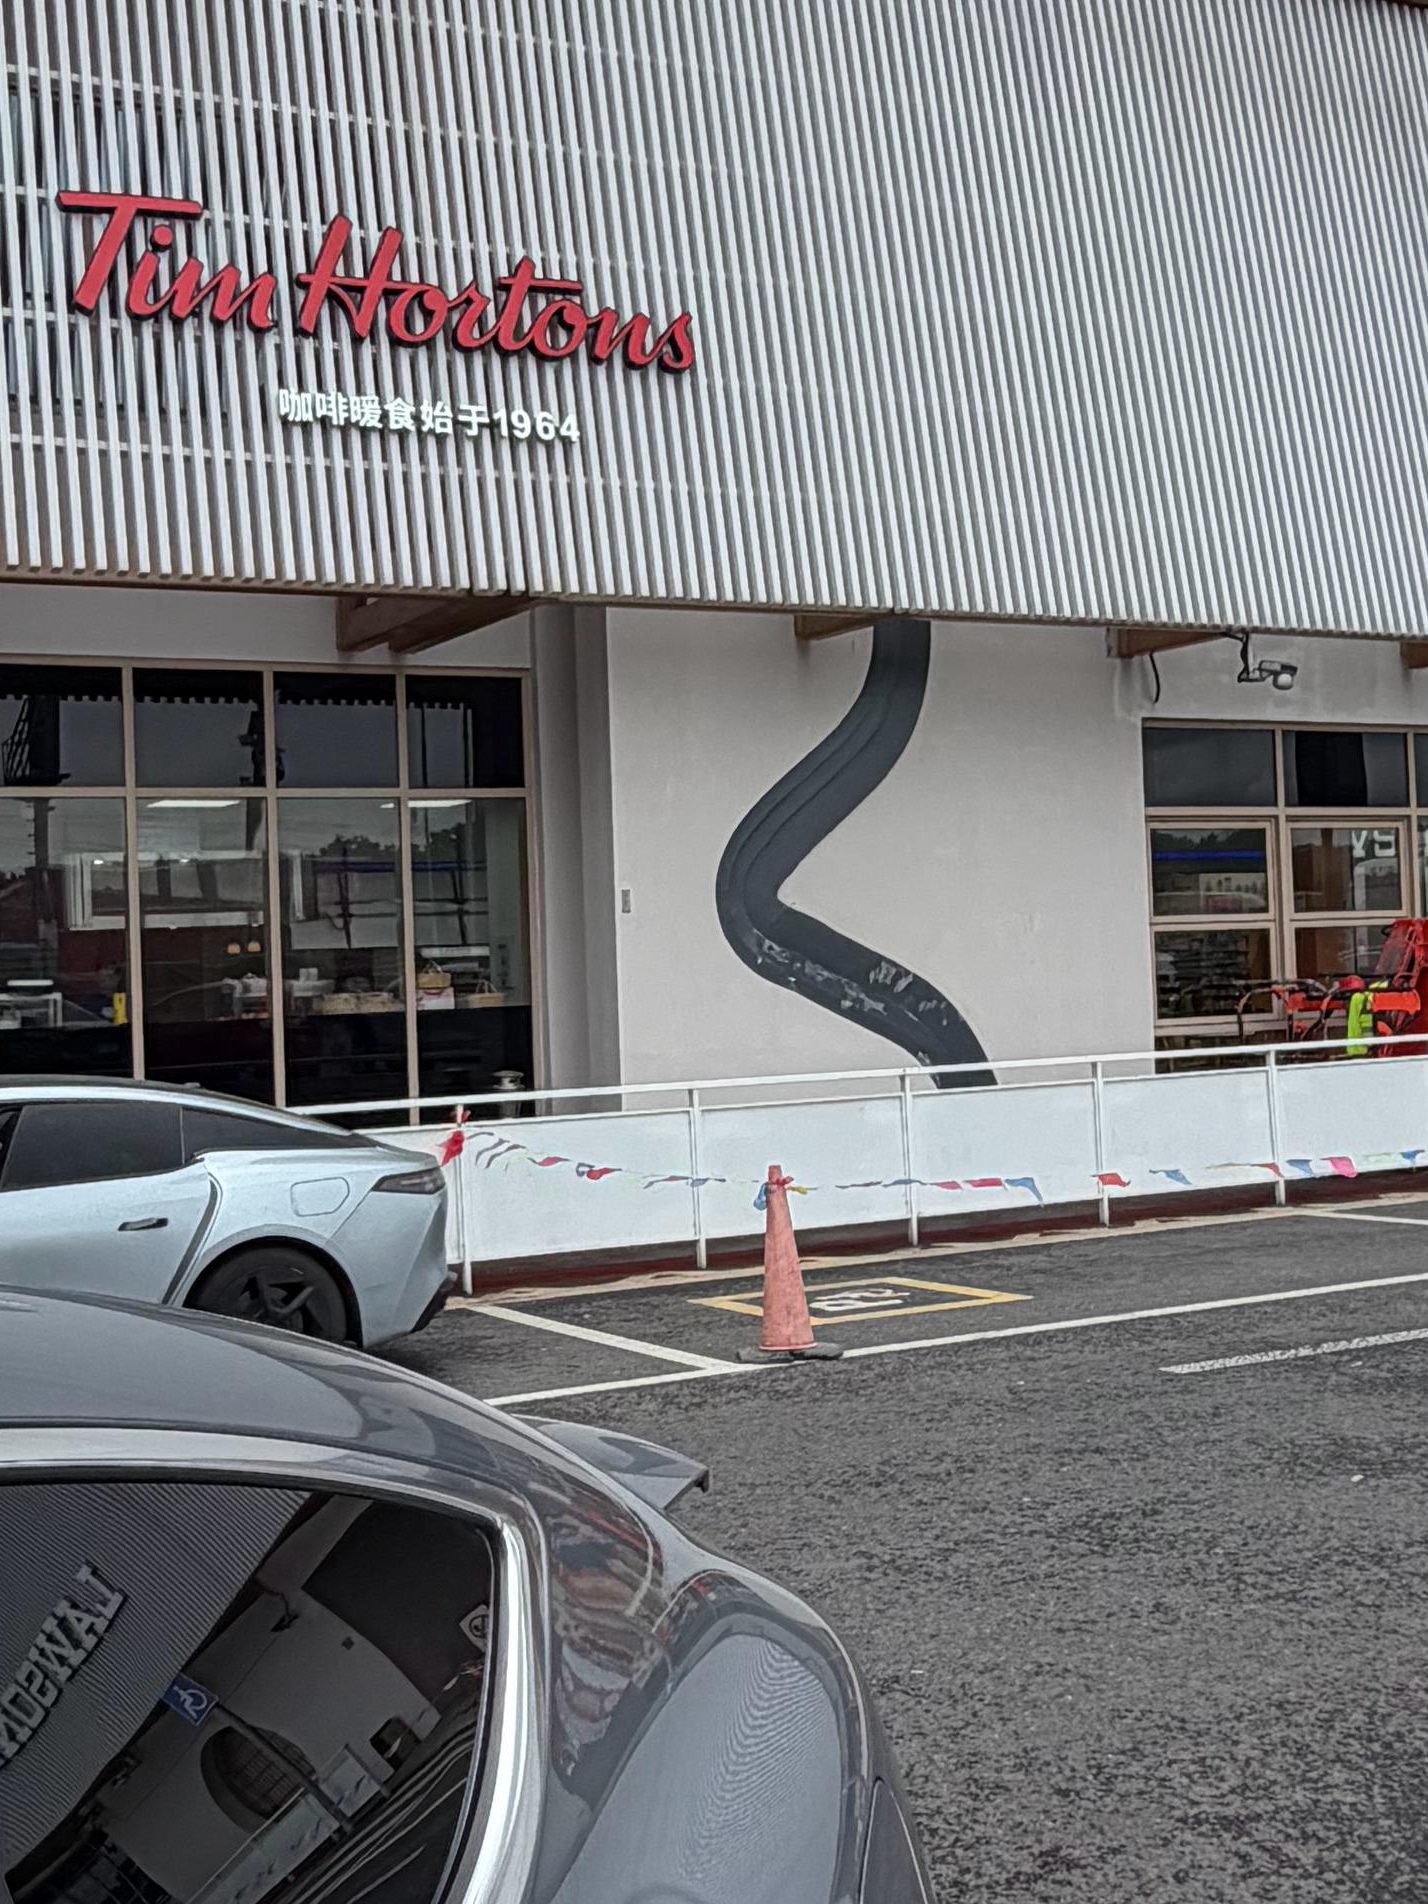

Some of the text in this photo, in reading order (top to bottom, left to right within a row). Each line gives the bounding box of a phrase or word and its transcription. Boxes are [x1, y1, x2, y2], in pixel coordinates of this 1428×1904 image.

[55, 190, 694, 375] Tim Hortons
[278, 386, 581, 443] 咖啡暖食始于1964
